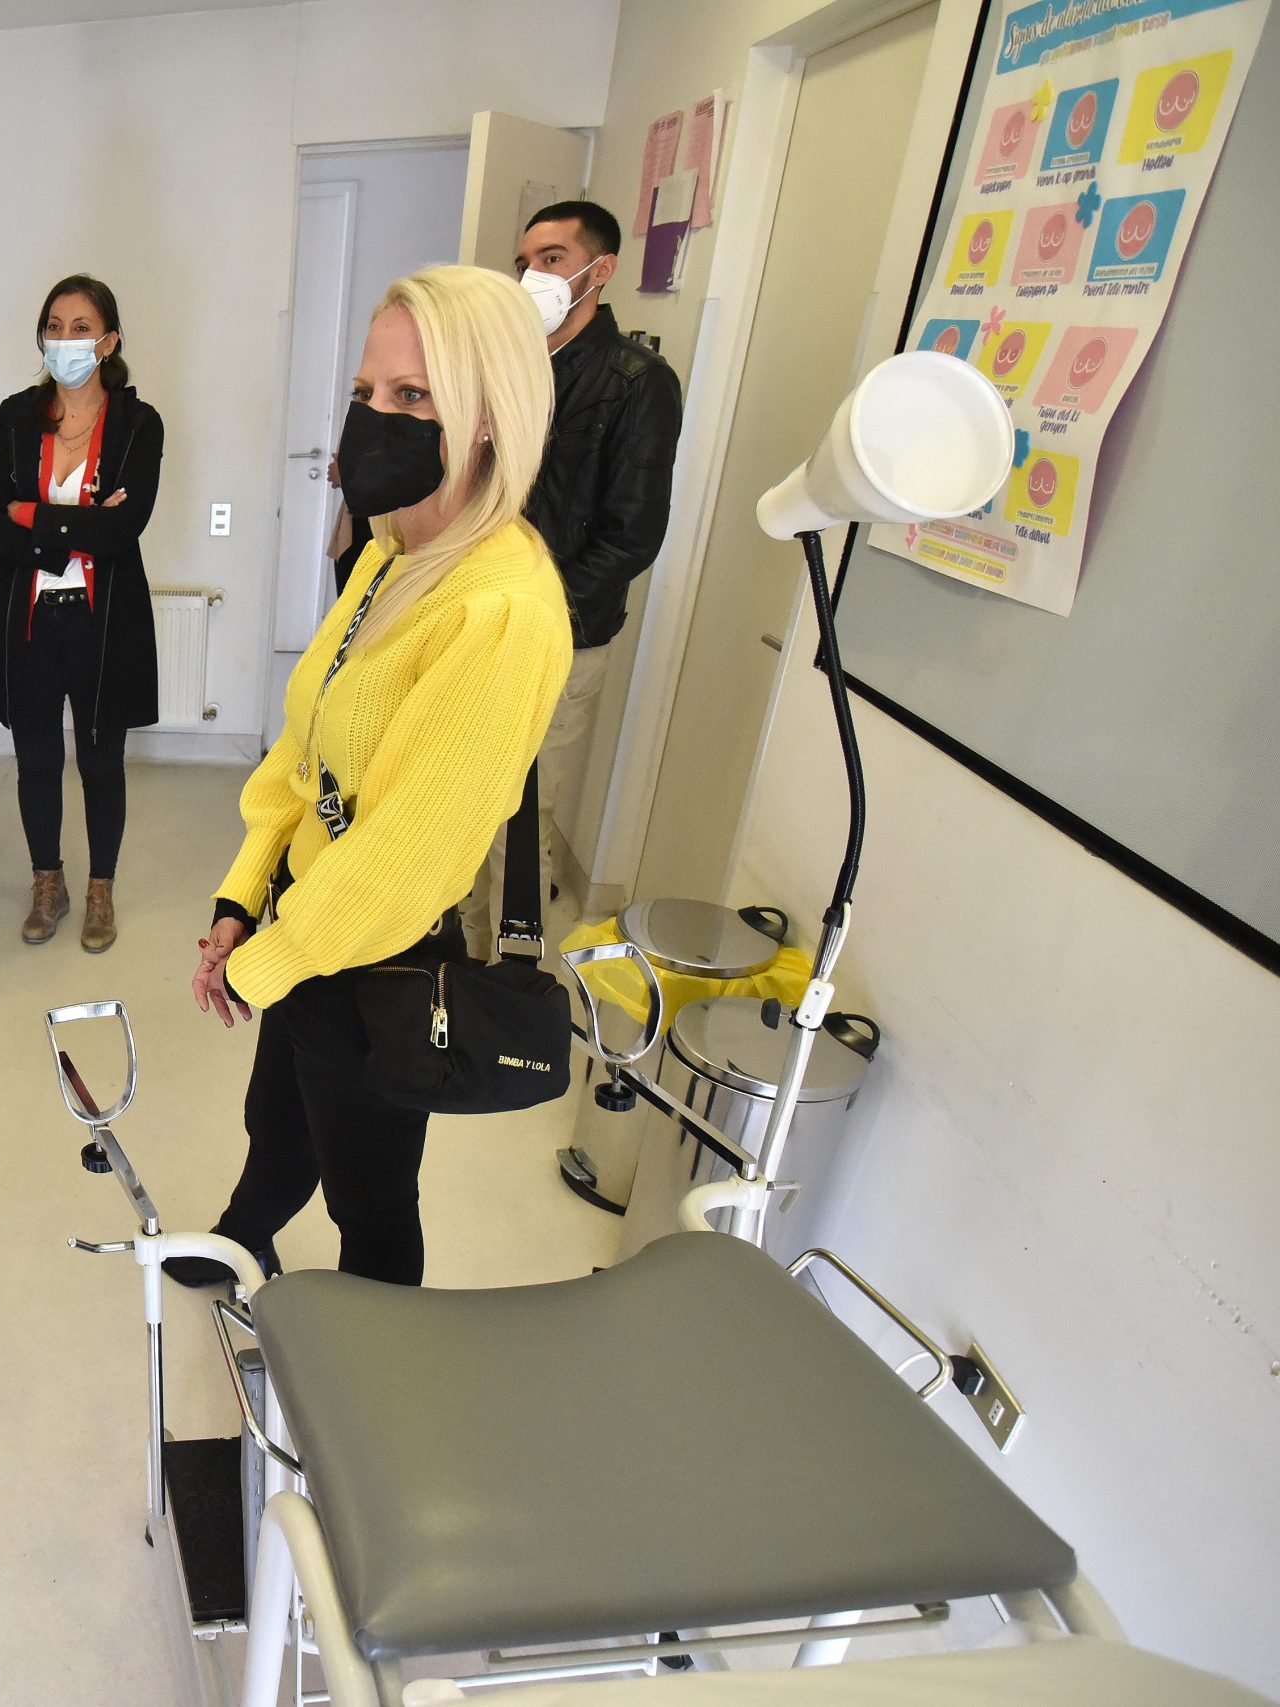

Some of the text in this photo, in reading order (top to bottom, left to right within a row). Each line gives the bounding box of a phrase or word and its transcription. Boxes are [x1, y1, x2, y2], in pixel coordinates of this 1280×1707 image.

[498, 1054, 552, 1073] BIMBA Y LOLA
